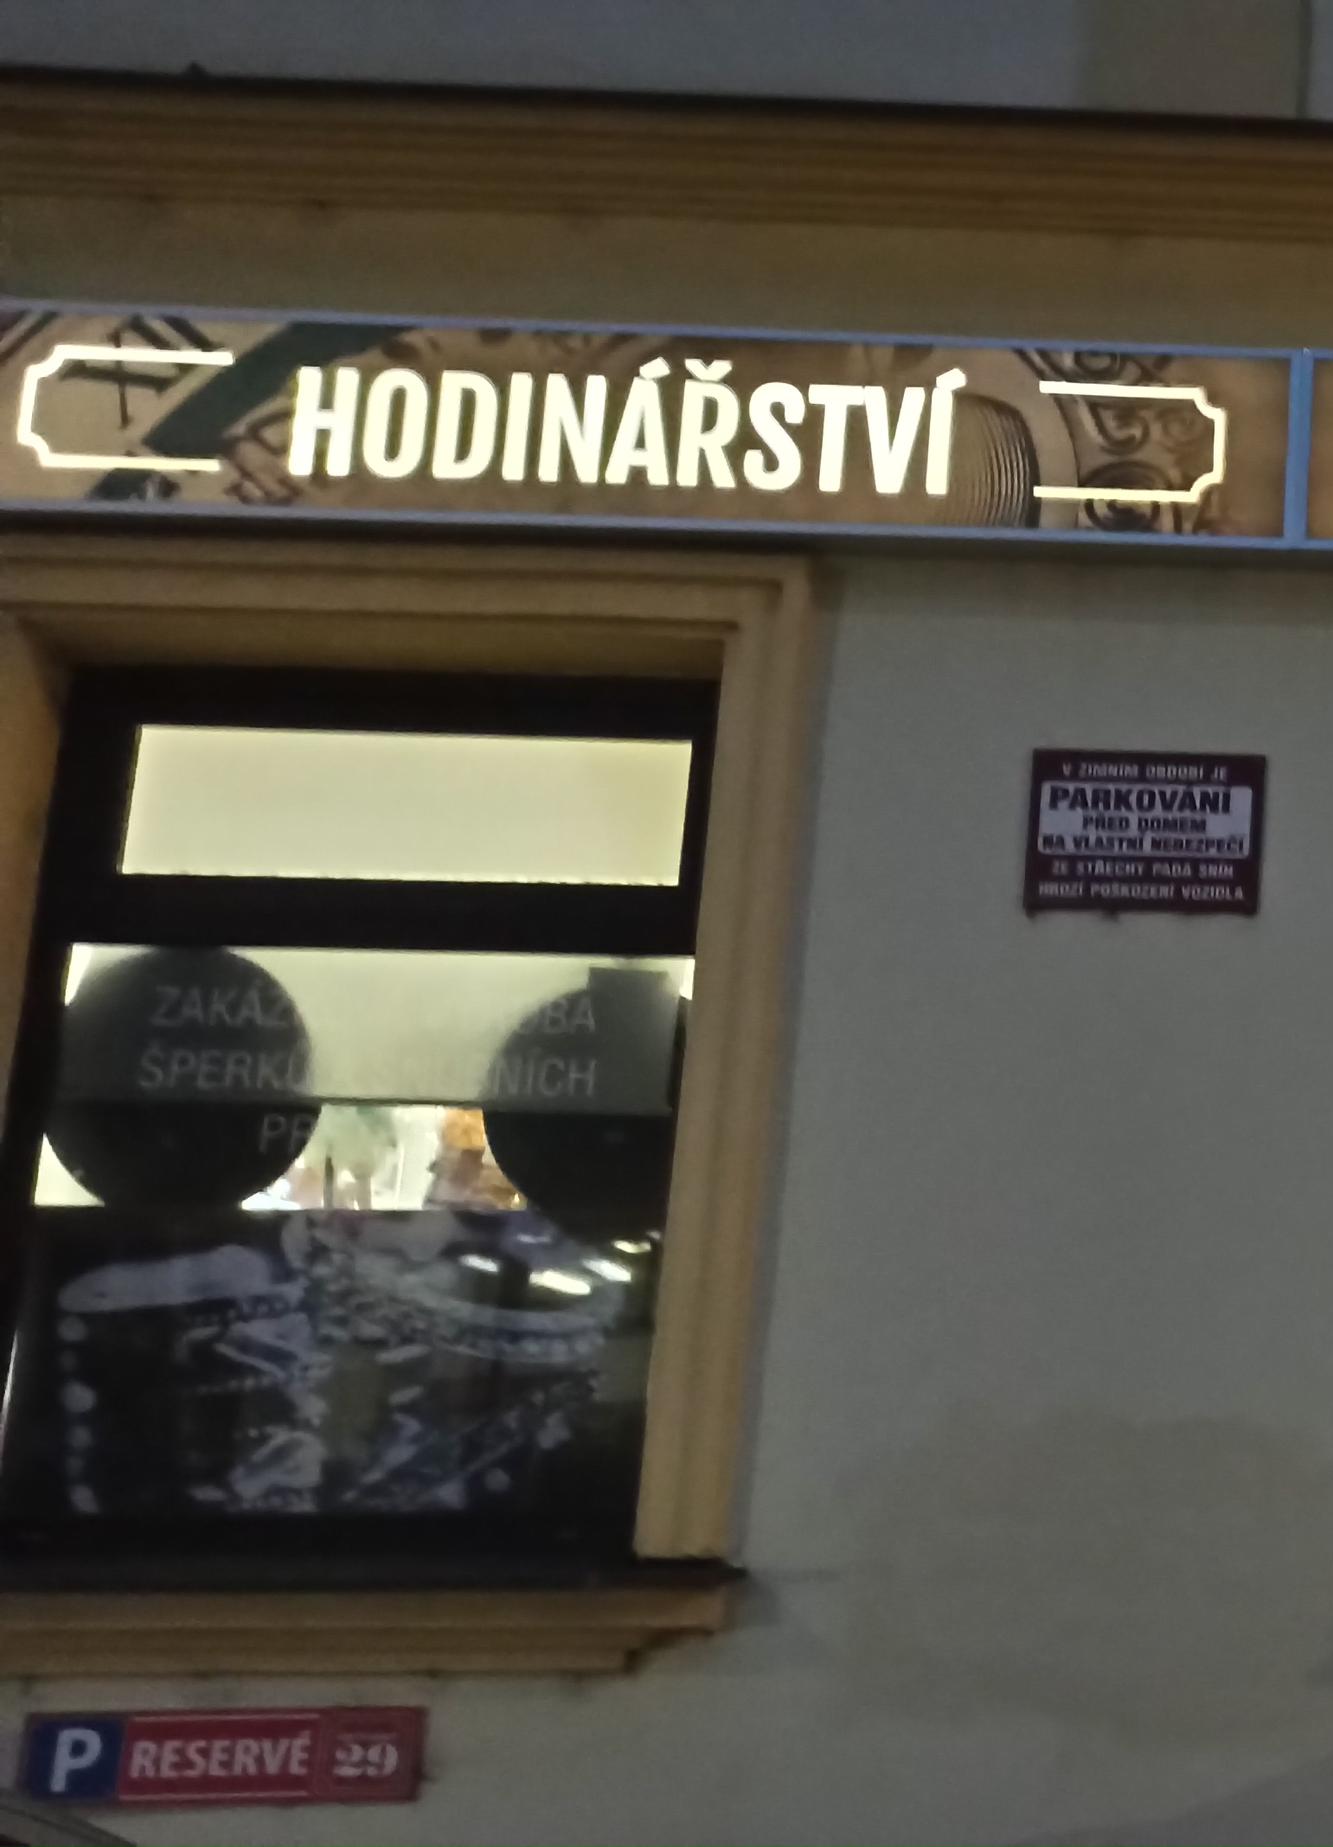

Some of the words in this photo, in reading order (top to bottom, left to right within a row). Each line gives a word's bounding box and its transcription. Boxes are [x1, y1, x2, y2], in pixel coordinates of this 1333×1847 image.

[288, 359, 966, 495] HODINÁŘSTVÍ
[1050, 784, 1232, 814] PARKOVÁNÍ
[1083, 814, 1130, 831] PŘED
[1138, 816, 1207, 833] DOMEM
[1042, 835, 1066, 850] NA
[1182, 885, 1244, 900] VOZIDLA
[50, 1727, 102, 1793] P
[129, 1730, 312, 1779] RESERVÉ
[333, 1743, 399, 1778] 29
